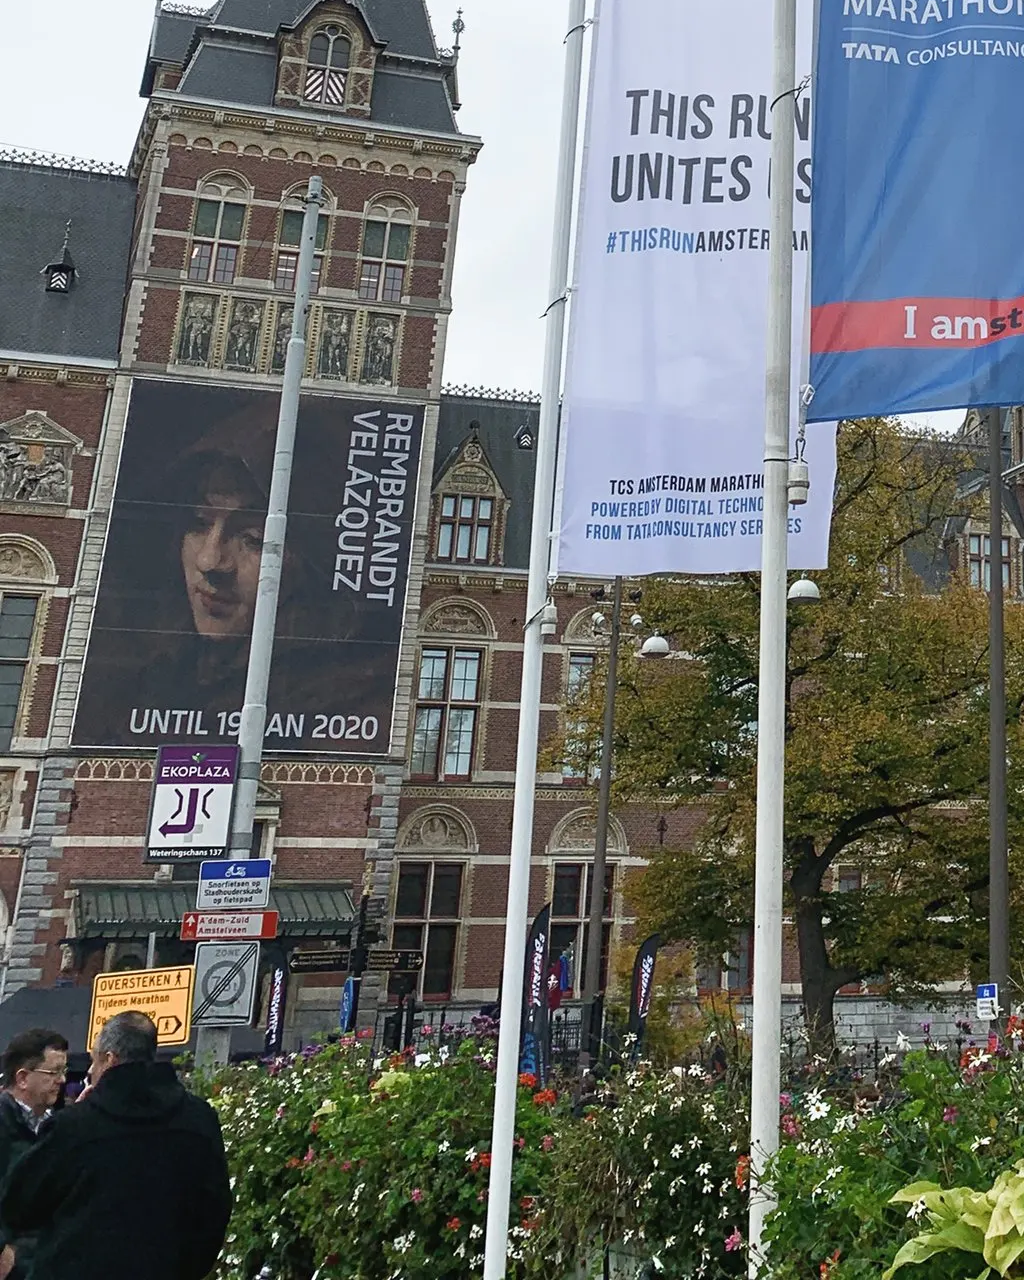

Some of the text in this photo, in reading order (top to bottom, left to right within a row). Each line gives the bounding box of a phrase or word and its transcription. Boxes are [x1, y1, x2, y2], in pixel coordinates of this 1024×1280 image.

[842, 42, 900, 65] TATA
[626, 89, 715, 141] THIS
[610, 152, 753, 205] UNITES
[904, 305, 917, 338] I
[610, 479, 634, 495] TCS
[638, 475, 705, 494] AMSTERDAM
[332, 410, 381, 592] VELÁZQUEZ
[366, 411, 414, 607] REMBRANDT
[591, 501, 650, 518] POWERED
[665, 497, 714, 516] DIGITAL
[586, 523, 621, 540] FROM
[626, 523, 653, 540] TATA
[652, 520, 736, 539] CONSULTANCY
[129, 708, 378, 745] UNTIL 19 AN 2020
[161, 766, 230, 778] EKOPLAZA
[149, 848, 222, 858] Weteringschans 137
[223, 896, 253, 904] fietspad
[198, 926, 247, 935] Amstelveen
[215, 948, 241, 957] ZONE
[100, 974, 171, 992] OVERSTEKEN
[98, 994, 170, 1010] Tijdens Marathon
